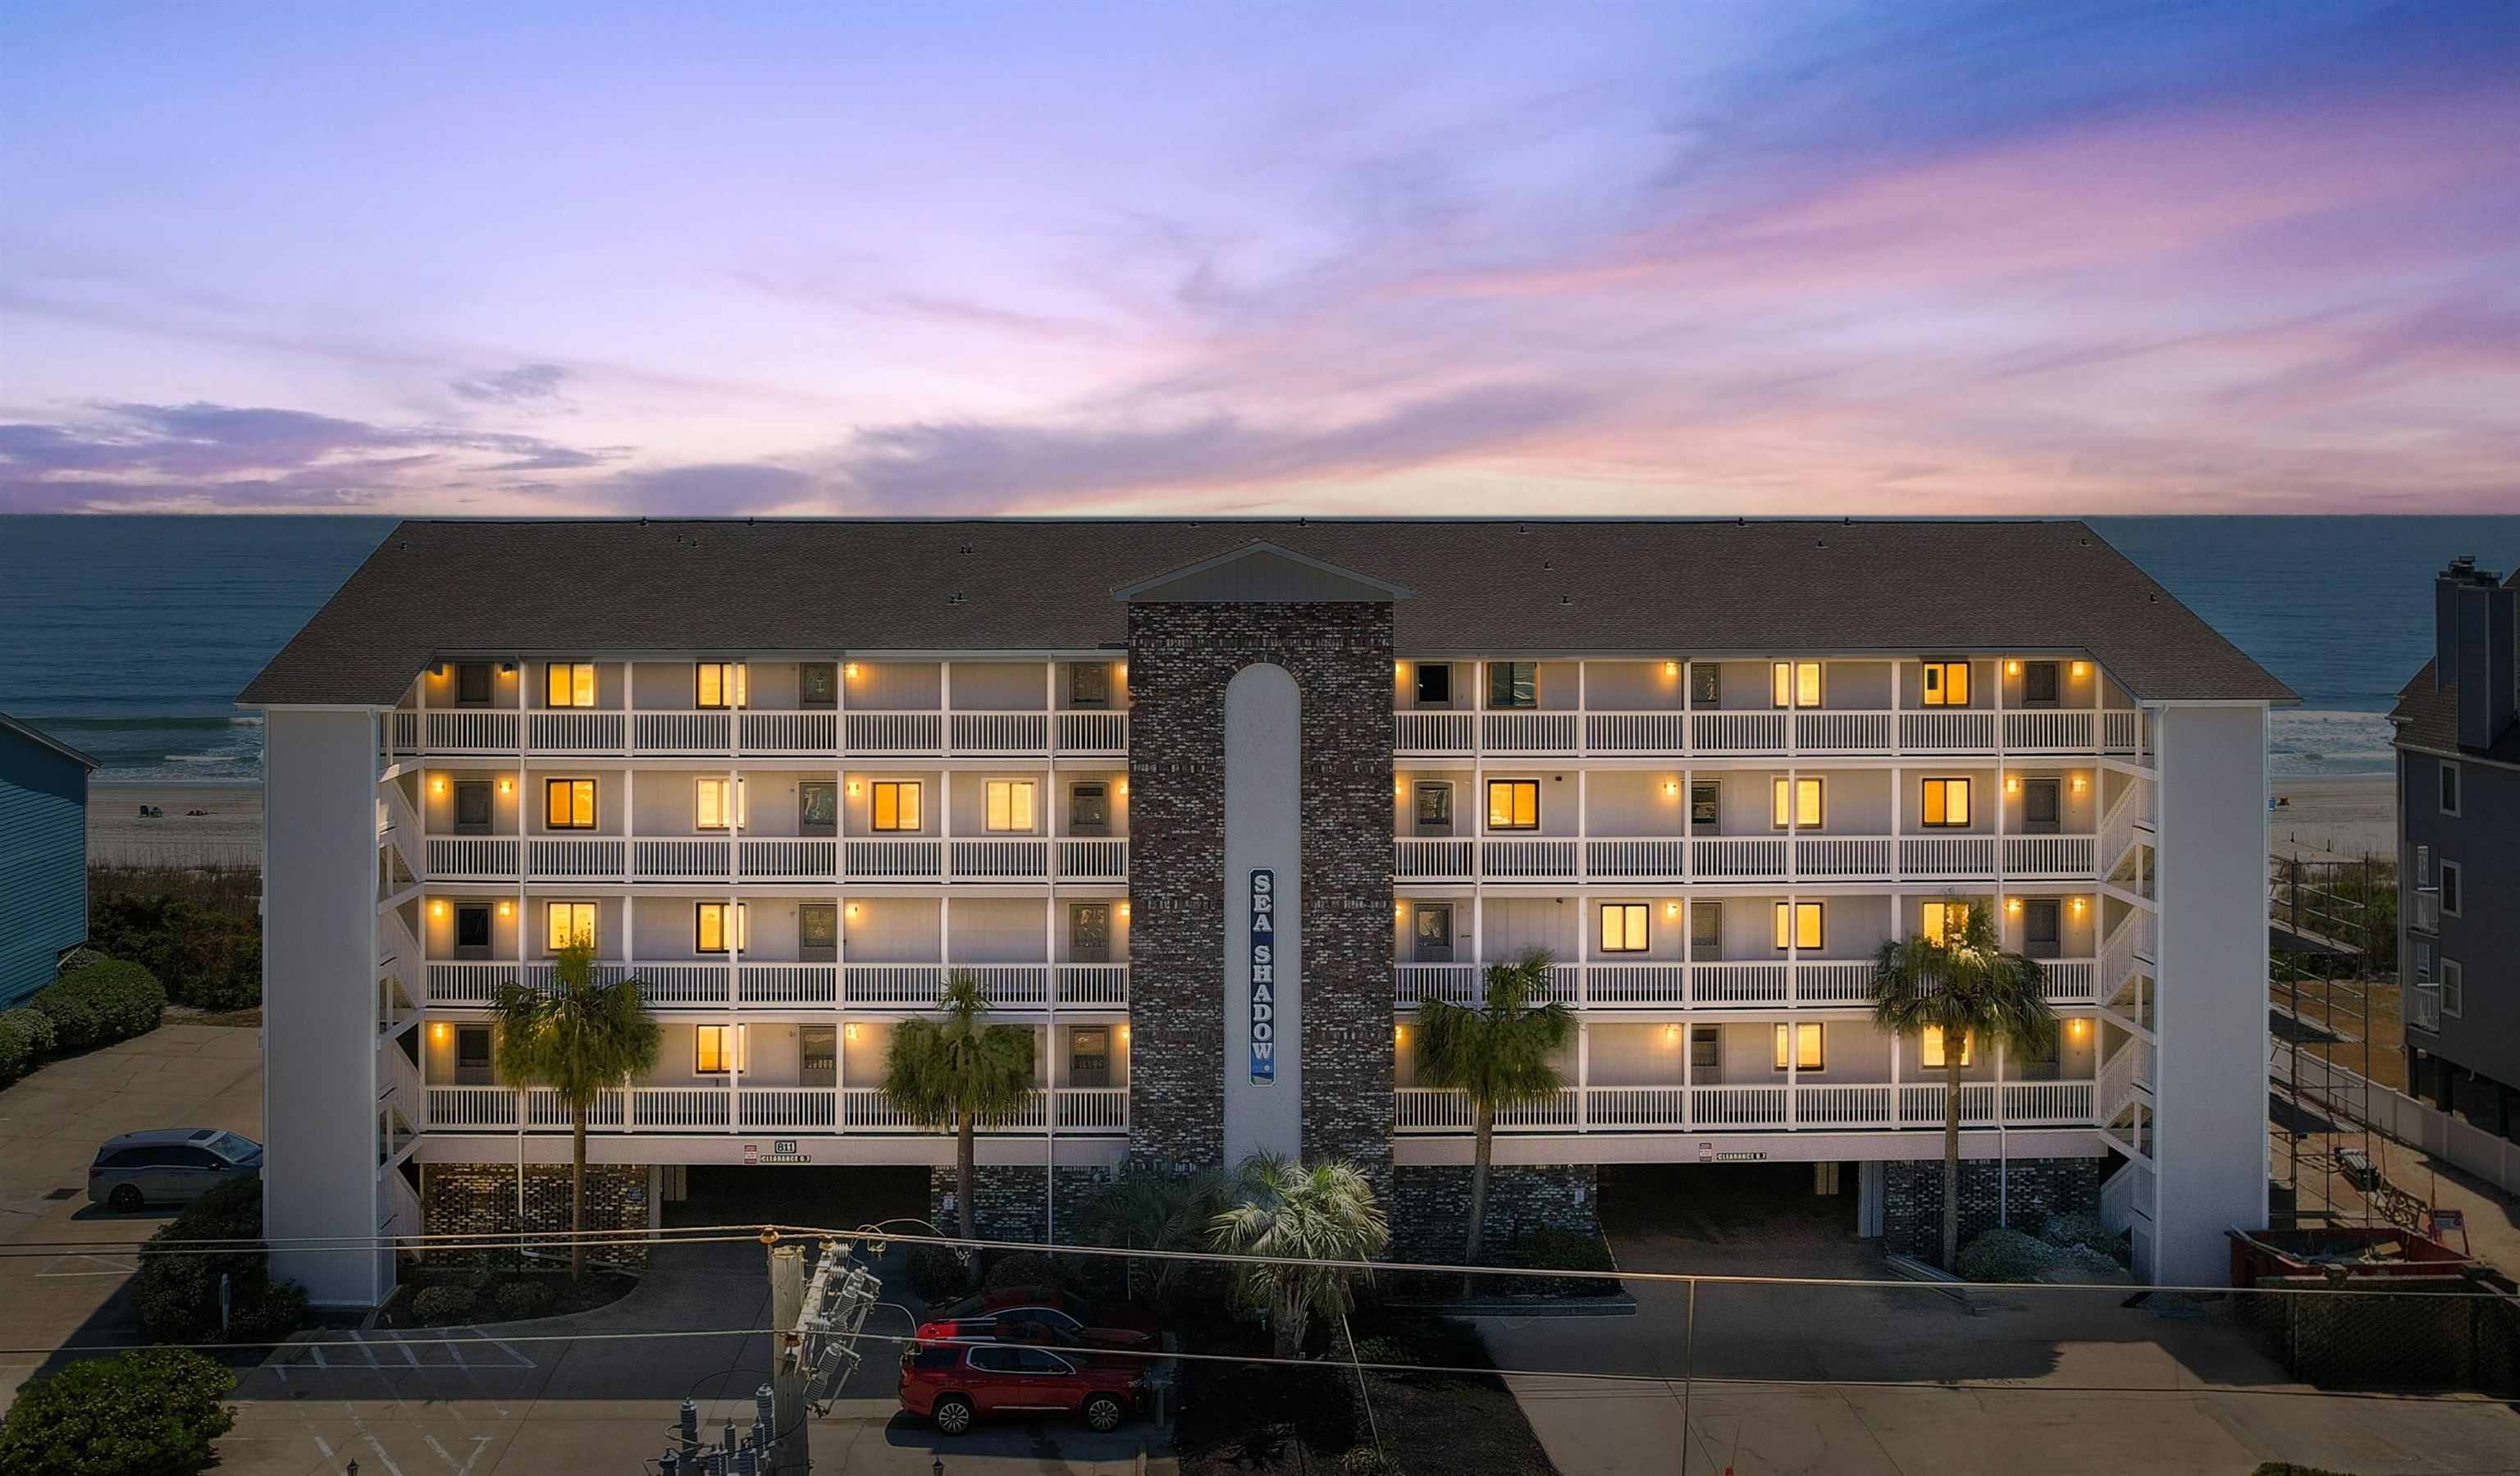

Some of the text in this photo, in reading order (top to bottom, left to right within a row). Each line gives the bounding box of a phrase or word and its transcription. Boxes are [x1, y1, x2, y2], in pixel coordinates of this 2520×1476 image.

[1252, 875, 1273, 1059] SEA SHADOW
[777, 1143, 793, 1152] 811
